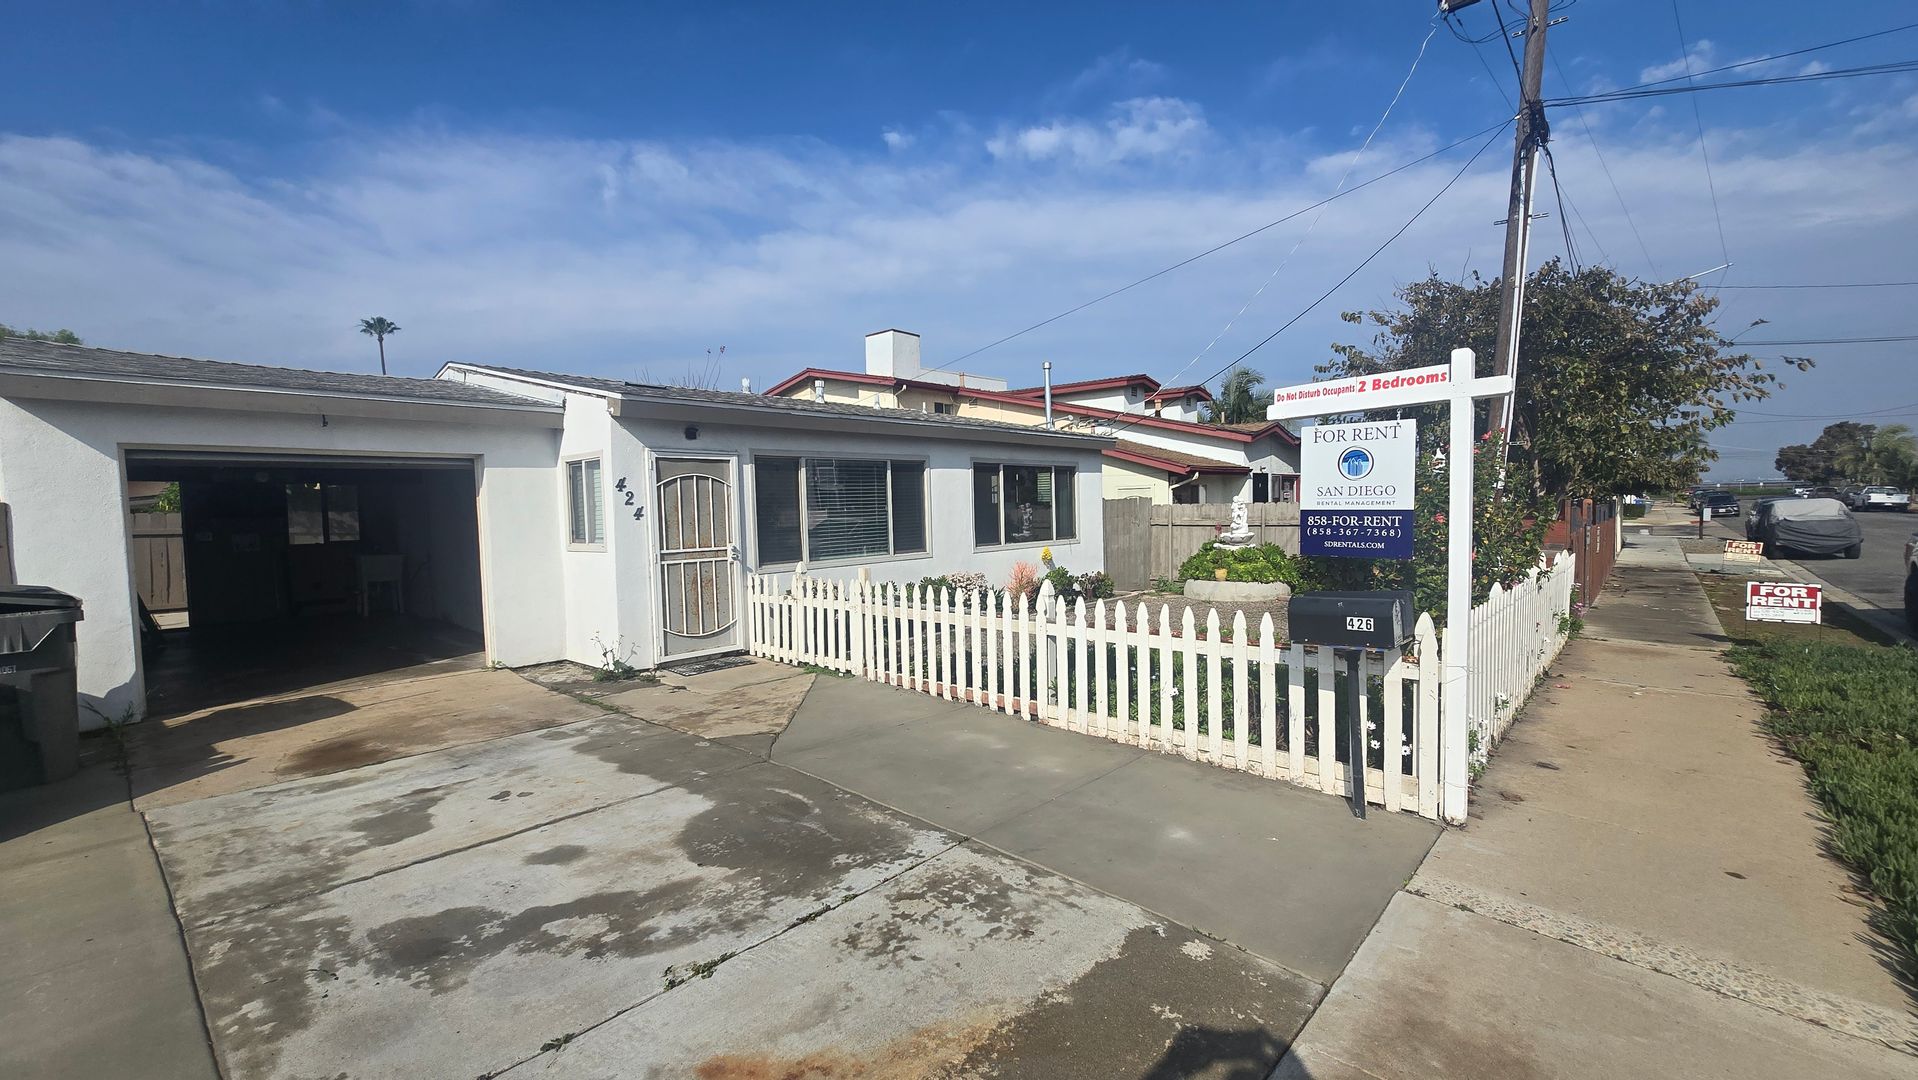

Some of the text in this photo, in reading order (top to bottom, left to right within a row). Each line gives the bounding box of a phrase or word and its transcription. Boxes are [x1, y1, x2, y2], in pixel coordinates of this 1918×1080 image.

[1357, 371, 1447, 393] 2 Bedrooms
[1276, 384, 1355, 402] Do Not Disturb Occupants
[1313, 425, 1402, 444] FOR RENT
[1316, 485, 1396, 497] SAN DIEGO
[615, 477, 644, 520] 424
[1307, 515, 1403, 527] 858-FOR-RENT
[1324, 541, 1385, 549] SDRENTALS.COM
[1760, 586, 1808, 597] FOR
[1752, 596, 1815, 608] RENT
[1347, 617, 1373, 631] 426
